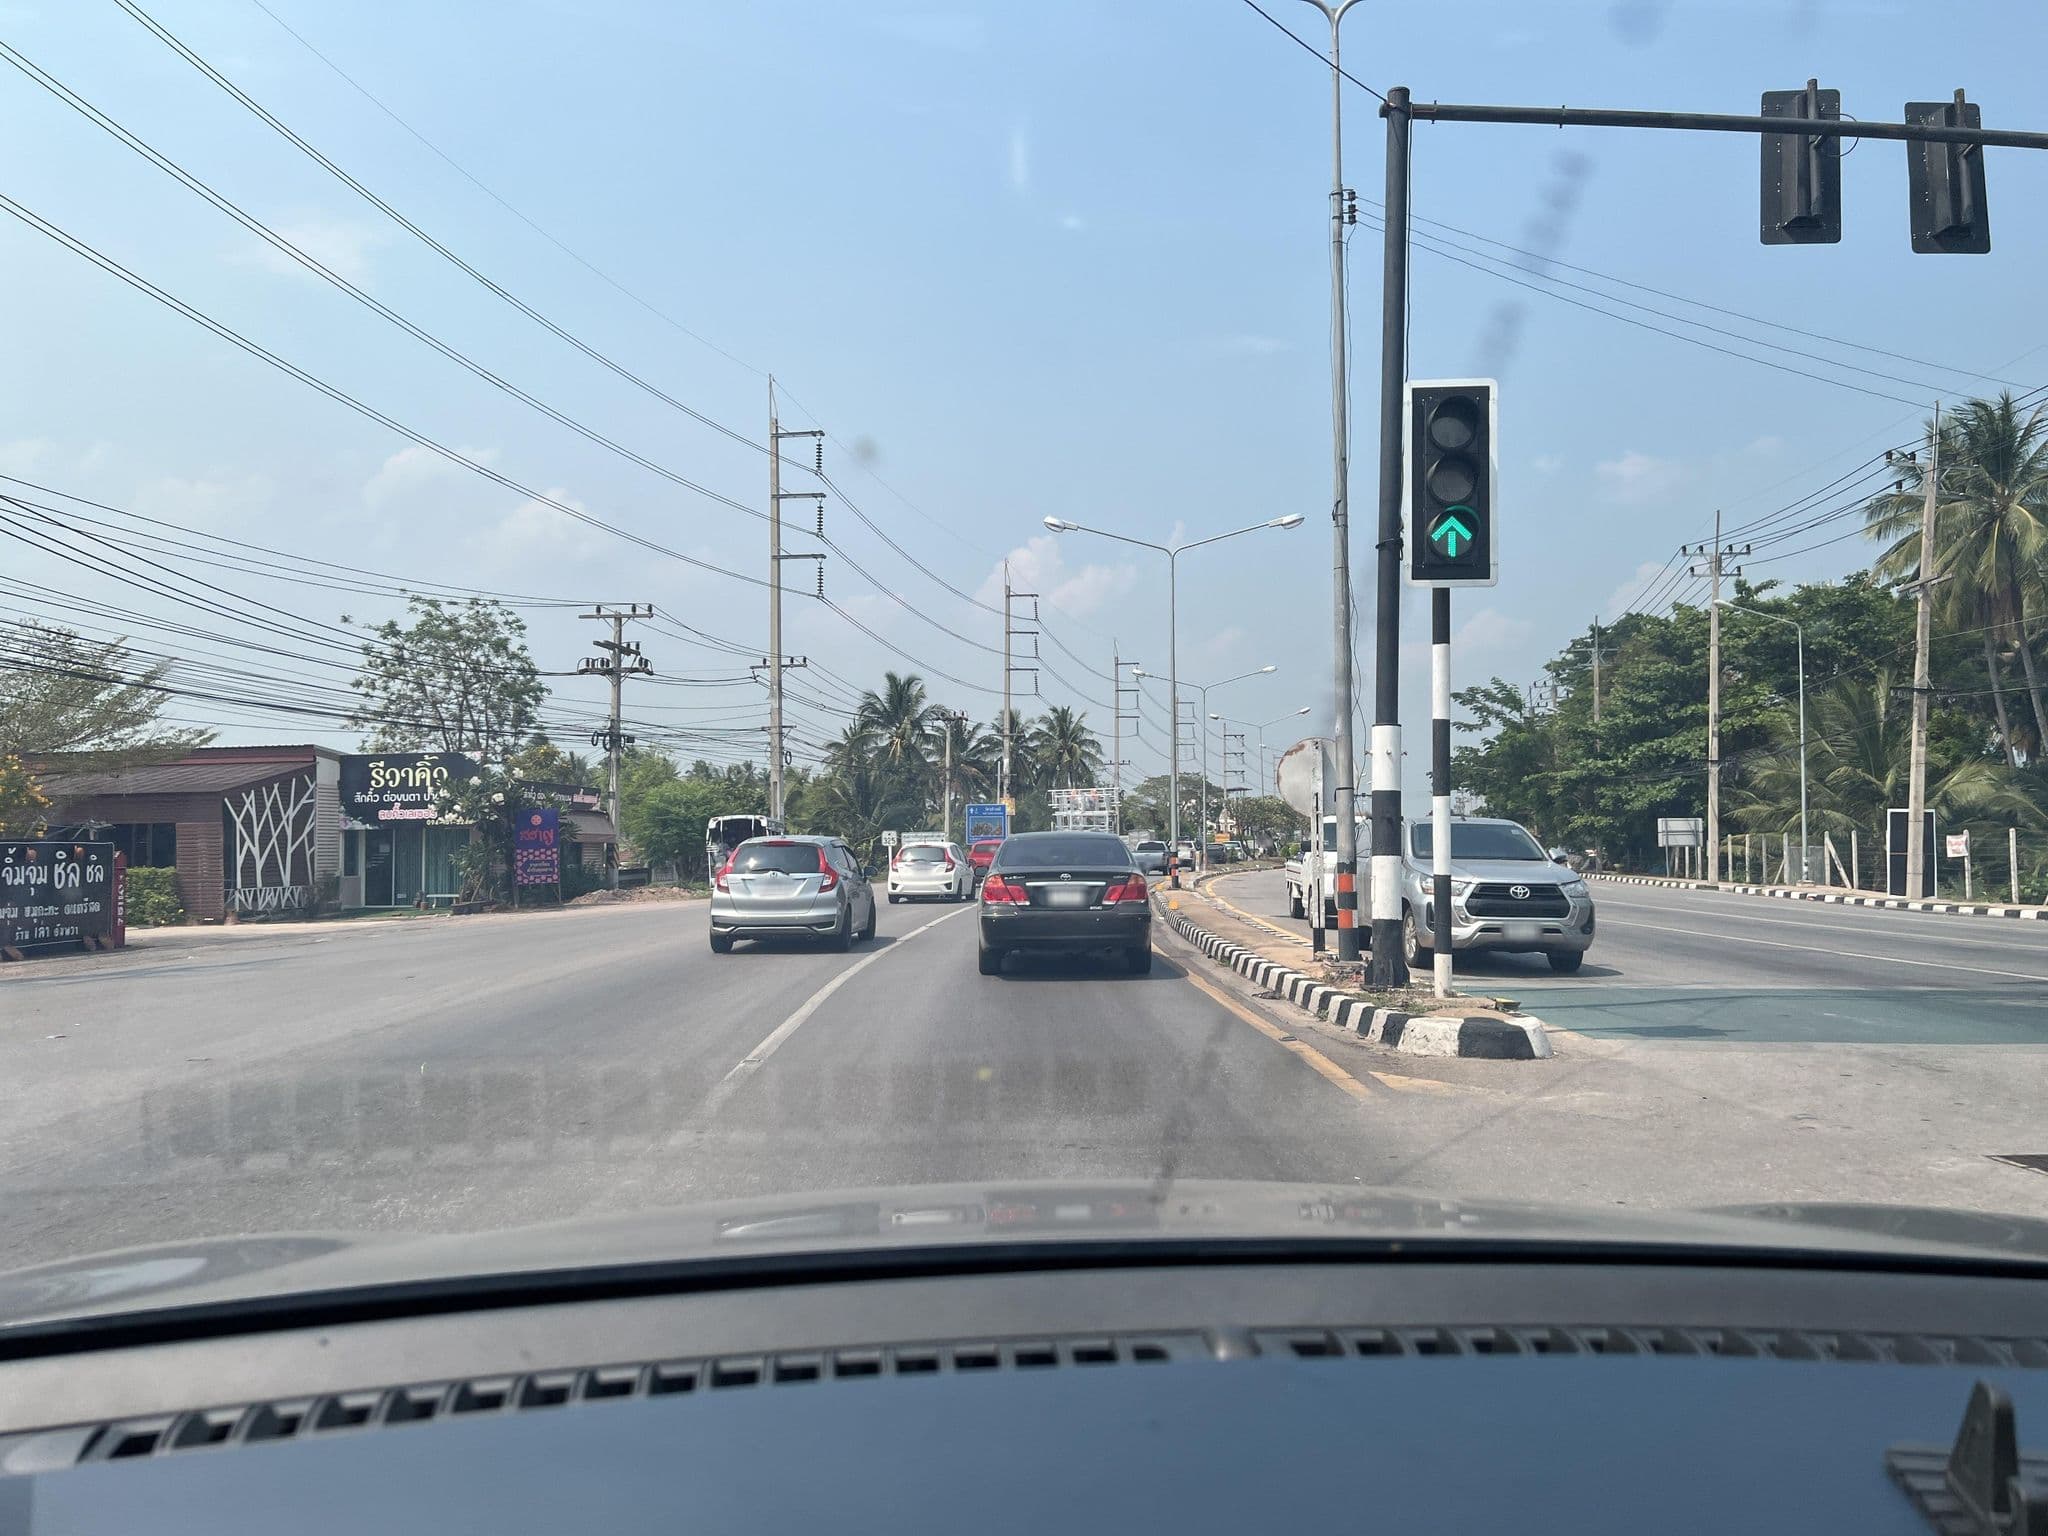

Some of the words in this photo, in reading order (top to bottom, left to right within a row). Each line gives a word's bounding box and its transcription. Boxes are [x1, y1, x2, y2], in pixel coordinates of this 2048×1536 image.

[354, 787, 380, 803] สักคิ้ว
[382, 790, 421, 802] ต่อขนตา
[54, 851, 81, 890] ชิล
[86, 854, 104, 883] ชิล
